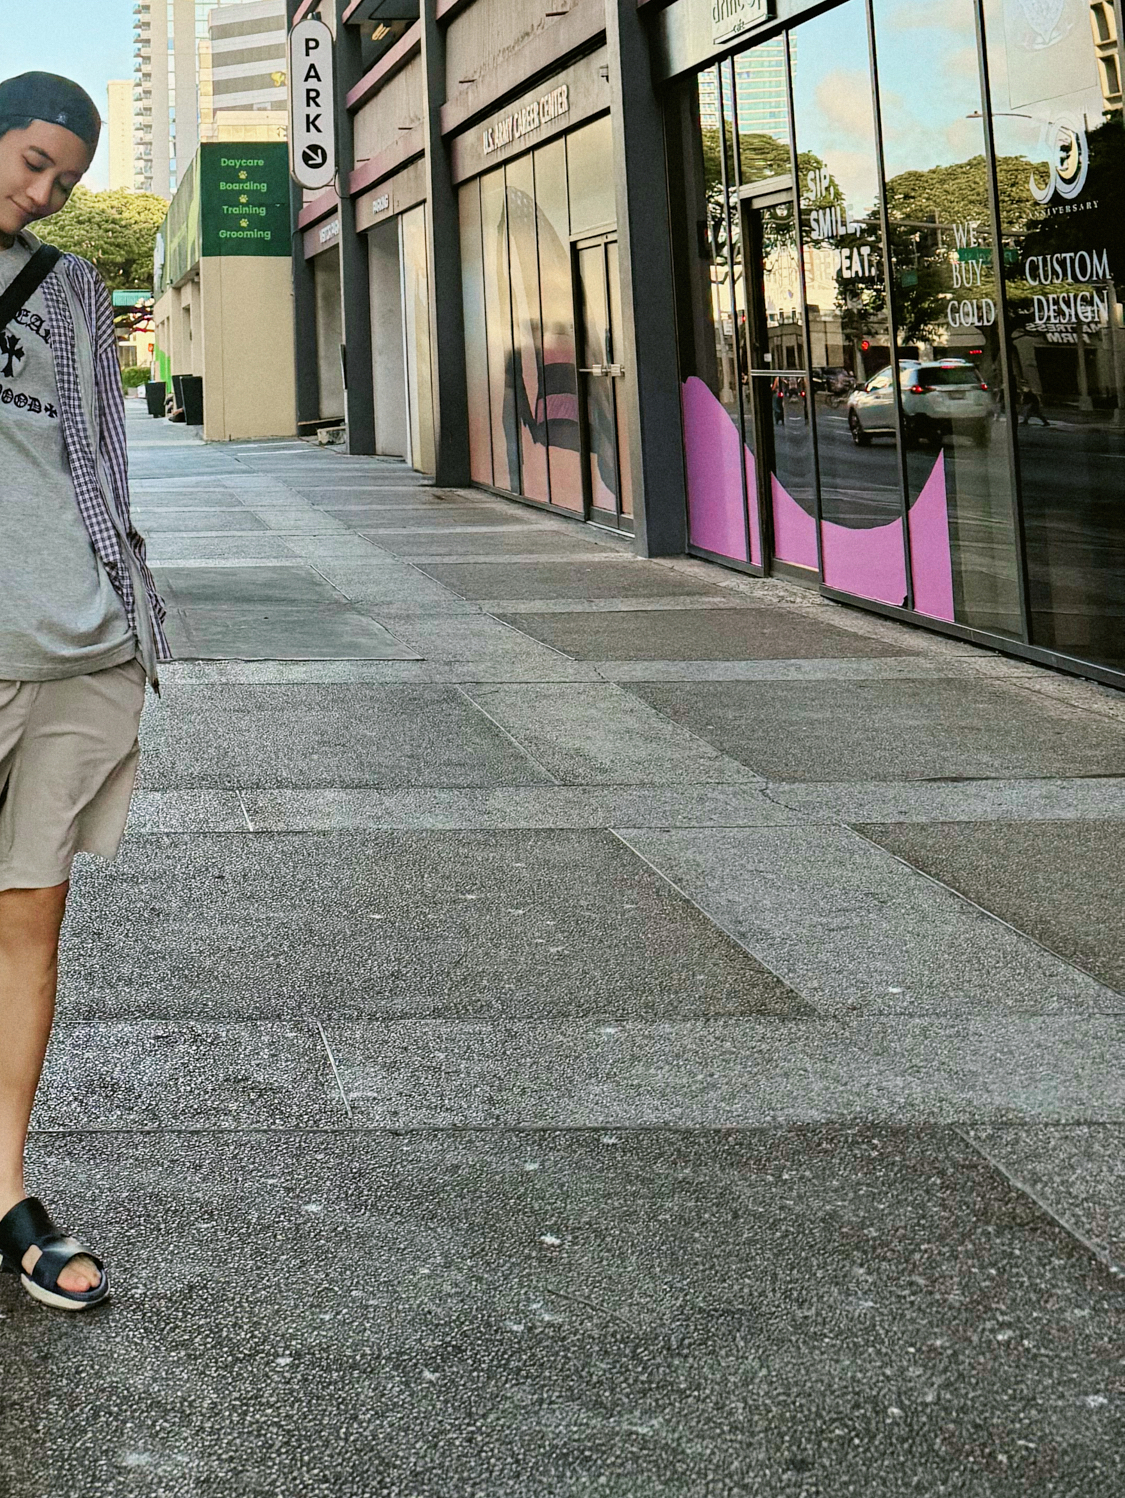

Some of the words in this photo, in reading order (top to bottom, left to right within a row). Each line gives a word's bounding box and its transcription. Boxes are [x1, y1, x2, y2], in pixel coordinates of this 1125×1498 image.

[304, 38, 323, 133] PARK
[514, 102, 540, 139] CAREER
[539, 84, 569, 124] CENTER
[220, 158, 264, 168] Daycare
[219, 181, 267, 192] Boarding
[222, 205, 266, 216] Training
[219, 229, 271, 240] Grooming
[952, 220, 981, 248] WE
[952, 259, 983, 288] BUY
[1025, 248, 1112, 286] CUSTOM
[947, 298, 995, 328] GOLD
[1033, 290, 1109, 324] DESIGN
